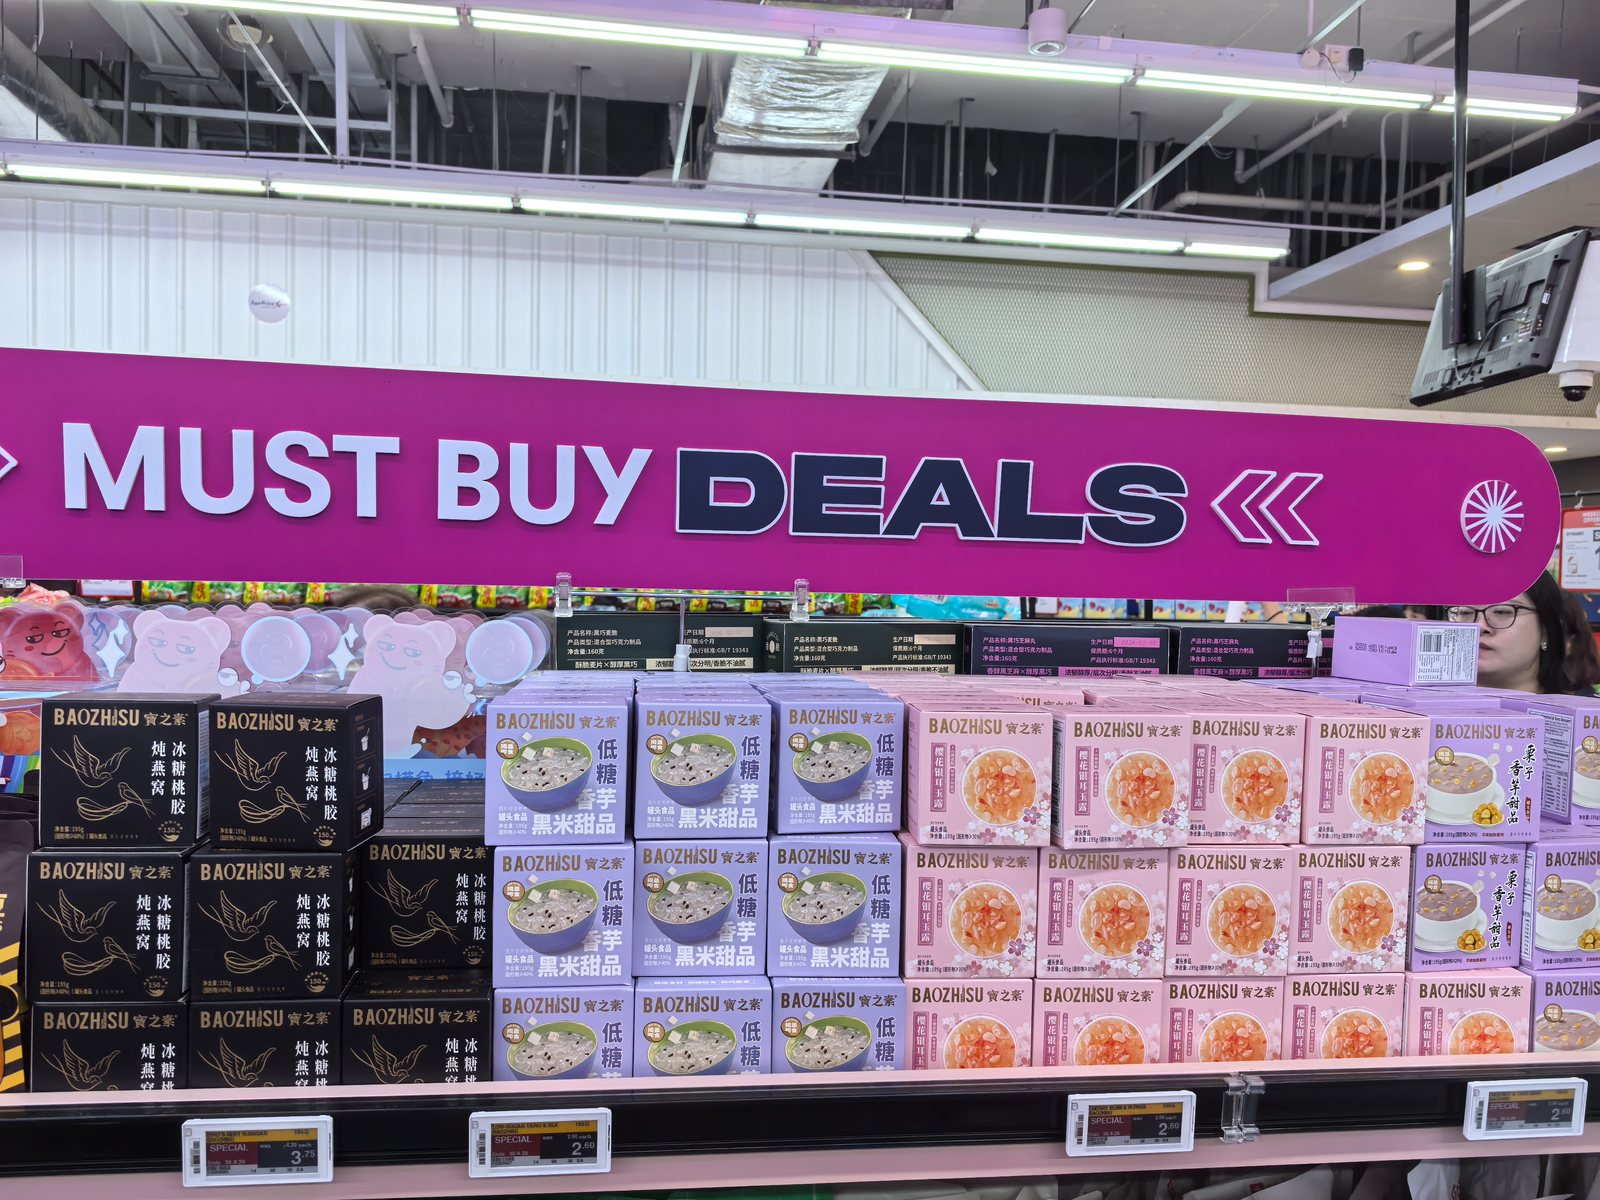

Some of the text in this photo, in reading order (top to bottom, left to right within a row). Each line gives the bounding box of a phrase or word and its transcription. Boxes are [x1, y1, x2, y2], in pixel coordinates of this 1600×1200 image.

[62, 421, 1189, 547] MUST BUY DEALS
[54, 707, 140, 726] BAOZHISU
[216, 711, 294, 732] BAOZHISU
[496, 711, 576, 730] BAOZHISU
[646, 709, 721, 727] BAOZHISU
[789, 708, 858, 725] BAOZHISU
[929, 717, 1002, 735] BAOZHISU
[1074, 721, 1144, 738] BAOZHISU
[1192, 719, 1260, 737] BAOZHISU
[1320, 722, 1387, 739] BAOZHISU
[1435, 722, 1501, 739] BAOZHISU
[596, 738, 618, 785] 低糖
[740, 736, 761, 781] 低糖
[875, 733, 895, 777] 低糖
[151, 740, 167, 796] 炖燕窝
[171, 741, 187, 815] 冰糖桃胶
[305, 746, 319, 801] 炖燕窝
[323, 747, 338, 821] 冰糖桃胶
[720, 783, 759, 805] 香芋
[858, 779, 894, 801] 香芋
[1506, 760, 1524, 824] 香芋甜品
[576, 788, 617, 810] 香芋
[678, 807, 758, 829] 黑米甜品
[819, 803, 893, 824] 黑米甜品
[531, 813, 616, 836] 黑米甜品
[369, 842, 446, 861] BAOZHISU
[643, 848, 718, 865] BAOZHISU
[777, 848, 851, 865] BAOZHISU
[917, 852, 989, 869] BAOZHISU
[1048, 853, 1119, 870] BAOZHISU
[1177, 853, 1247, 870] BAOZHISU
[1298, 851, 1366, 868] BAOZHISU
[1426, 851, 1487, 868] BAOZHISU
[39, 861, 125, 880] BAOZHISU
[200, 861, 285, 881] BAOZHISU
[502, 854, 581, 873] BAOZHISU
[455, 873, 469, 924] 炖燕窝
[602, 879, 624, 927] 低糖
[736, 873, 758, 919] 低糖
[870, 874, 891, 919] 低糖
[473, 873, 487, 941] 冰糖桃胶
[136, 894, 151, 951] 炖燕窝
[296, 893, 311, 948] 炖燕窝
[1488, 886, 1506, 950] 香芋甜品
[156, 894, 172, 969] 冰糖桃胶
[316, 893, 331, 967] 冰糖桃胶
[717, 921, 757, 943] 香芋
[851, 922, 891, 944] 香芋
[581, 929, 623, 952] 香芋
[537, 955, 622, 977] 黑米甜品
[675, 945, 756, 967] 黑米甜品
[810, 946, 890, 968] 黑米甜品
[912, 985, 984, 1003] BAOZHISU
[1043, 986, 1114, 1003] BAOZHISU
[1169, 982, 1238, 999] BAOZHISU
[1292, 980, 1359, 997] BAOZHISU
[1419, 982, 1486, 999] BAOZHISU
[502, 995, 580, 1014] BAOZHISU
[643, 994, 720, 1013] BAOZHISU
[781, 991, 855, 1008] BAOZHISU
[43, 1010, 129, 1030] BAOZHISU
[200, 1008, 284, 1028] BAOZHISU
[353, 1006, 435, 1026] BAOZHISU
[601, 1022, 623, 1069] 低糖
[740, 1020, 761, 1067] 低糖
[875, 1017, 896, 1062] 低糖
[1489, 1102, 1520, 1110] SPECIAL
[209, 1144, 249, 1152] SPECIAL
[494, 1135, 533, 1144] SPECIAL
[572, 1141, 595, 1156] 2.60
[291, 1149, 316, 1165] 3.75
